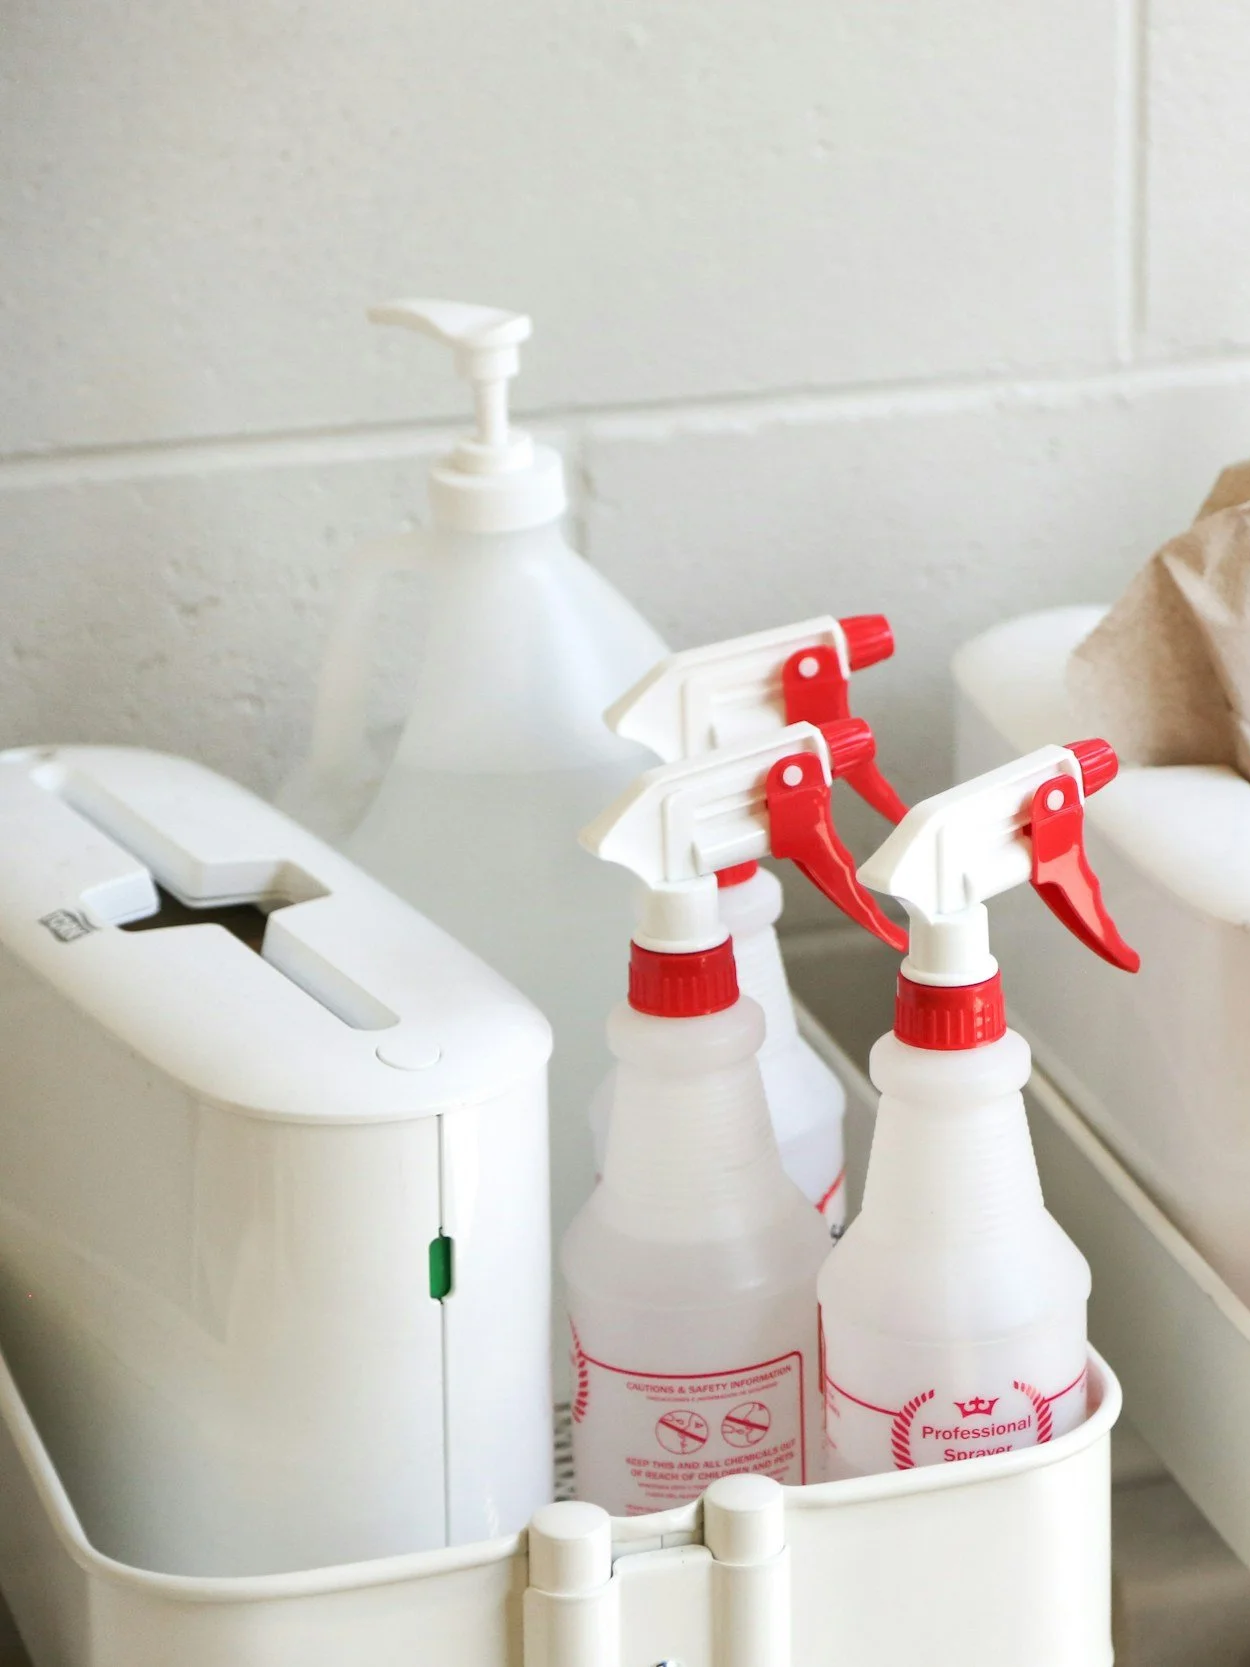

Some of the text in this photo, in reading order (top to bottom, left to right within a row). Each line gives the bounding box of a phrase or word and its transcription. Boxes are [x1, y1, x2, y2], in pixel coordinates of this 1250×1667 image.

[626, 1381, 674, 1394] CAUTIONS
[688, 1382, 727, 1393] SAFETY
[730, 1364, 792, 1389] INFORMATION
[922, 1415, 1031, 1440] Professional
[677, 1461, 699, 1470] AND
[702, 1460, 721, 1469] ALL
